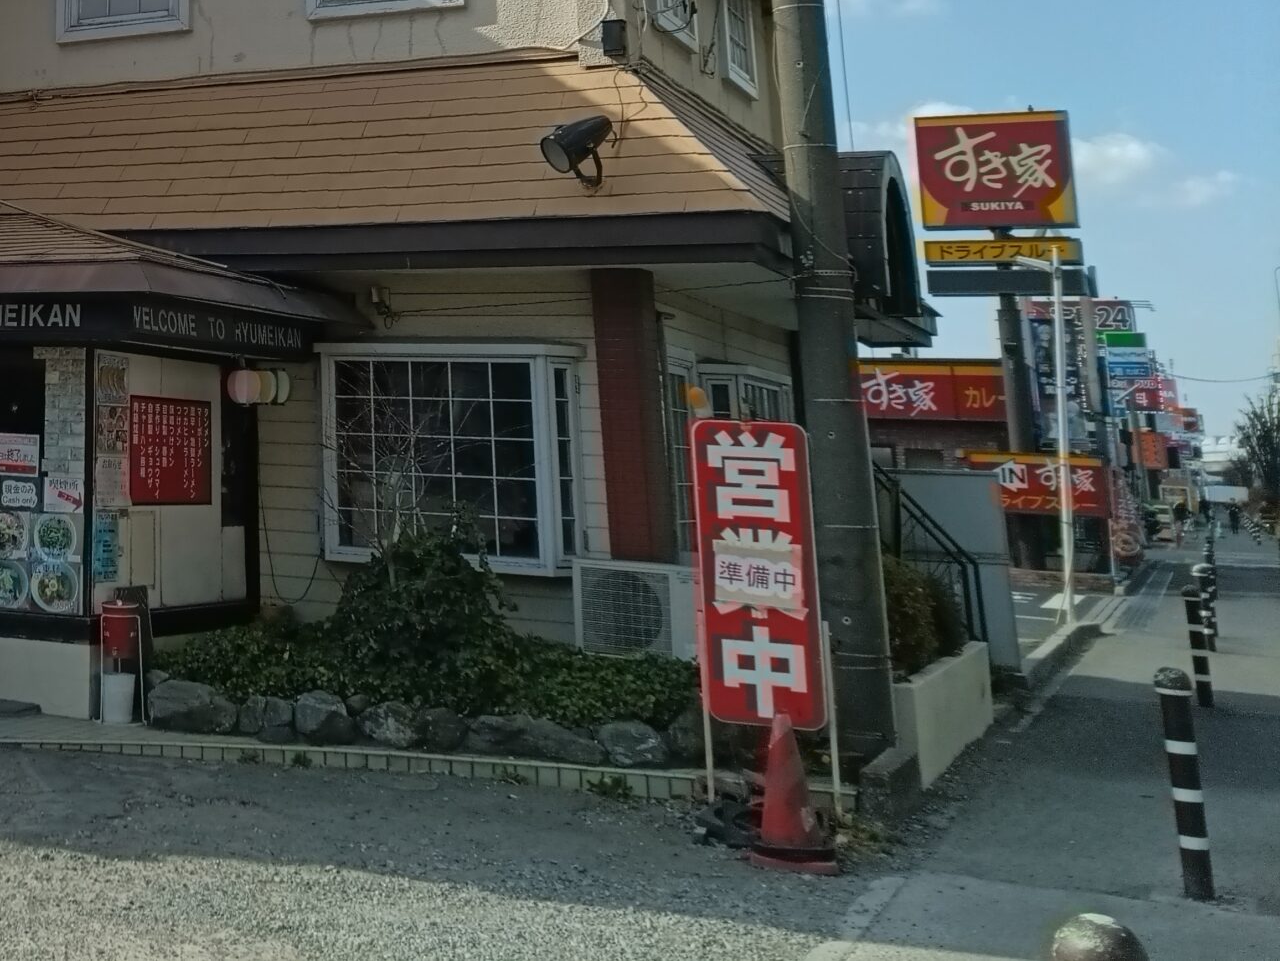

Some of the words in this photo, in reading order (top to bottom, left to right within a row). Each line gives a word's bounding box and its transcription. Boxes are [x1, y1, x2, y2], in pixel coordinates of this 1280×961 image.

[934, 127, 1057, 198] すき家
[970, 201, 1024, 211] SUKIYA
[940, 244, 1065, 260] ドライブスルー
[208, 317, 225, 340] TO
[235, 322, 302, 349] RYUMEIKAN
[861, 367, 938, 417] すき家
[1001, 467, 1026, 484] IN
[1034, 458, 1096, 496] す家
[3, 495, 20, 504] Cash
[21, 495, 37, 506] only
[4, 483, 34, 494] 現金のみ
[718, 559, 797, 593] 準備中
